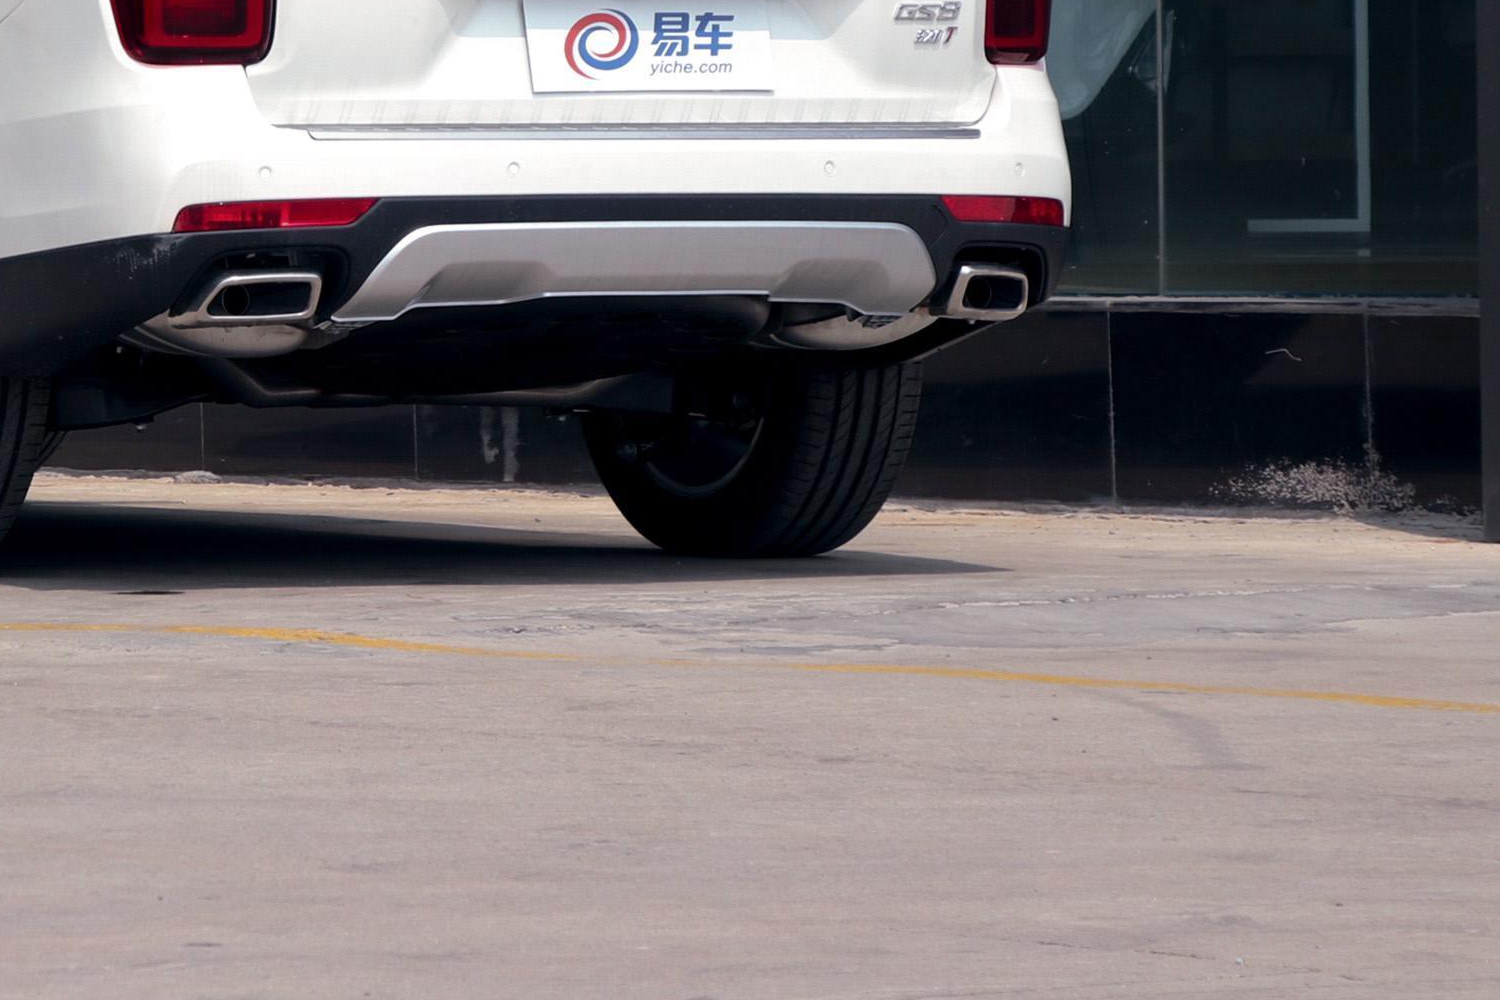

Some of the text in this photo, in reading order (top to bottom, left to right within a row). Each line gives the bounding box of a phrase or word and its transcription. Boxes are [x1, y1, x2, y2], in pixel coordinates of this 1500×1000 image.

[893, 1, 962, 22] GS8
[651, 12, 734, 56] 易车
[650, 61, 733, 76] yiche.com
